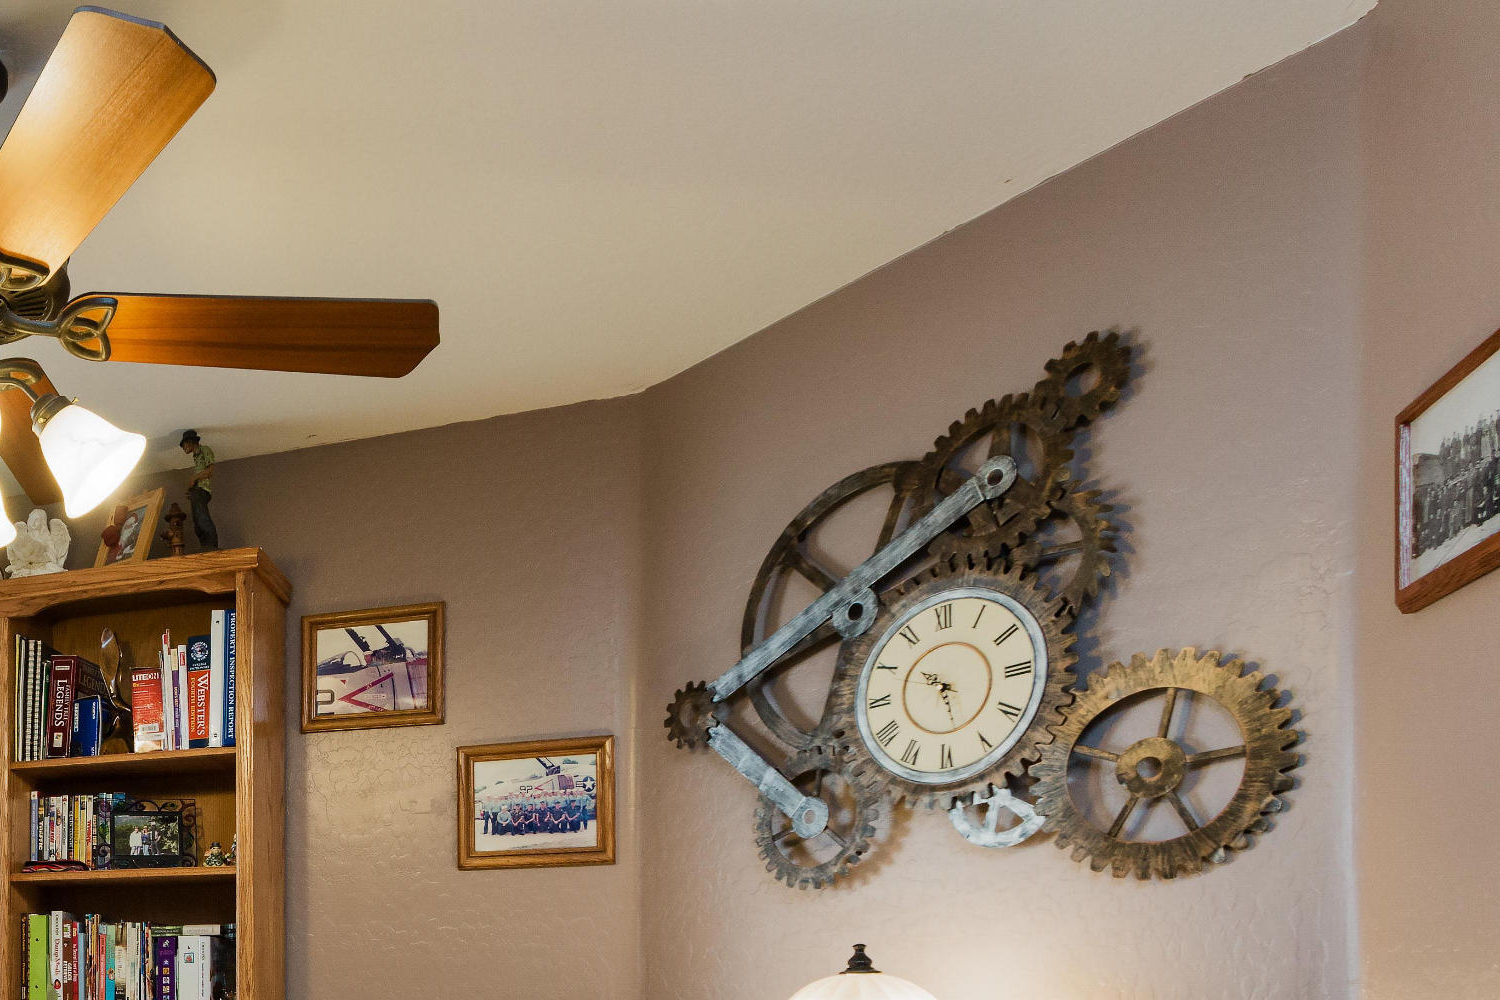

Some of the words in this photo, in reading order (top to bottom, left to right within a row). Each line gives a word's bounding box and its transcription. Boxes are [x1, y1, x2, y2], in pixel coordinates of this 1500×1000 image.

[228, 612, 236, 655] PROPERTY
[54, 679, 68, 727] LEGENDS
[196, 672, 209, 737] WEBSTER'S
[227, 656, 236, 706] INSPECTION
[227, 706, 235, 739] REPORT
